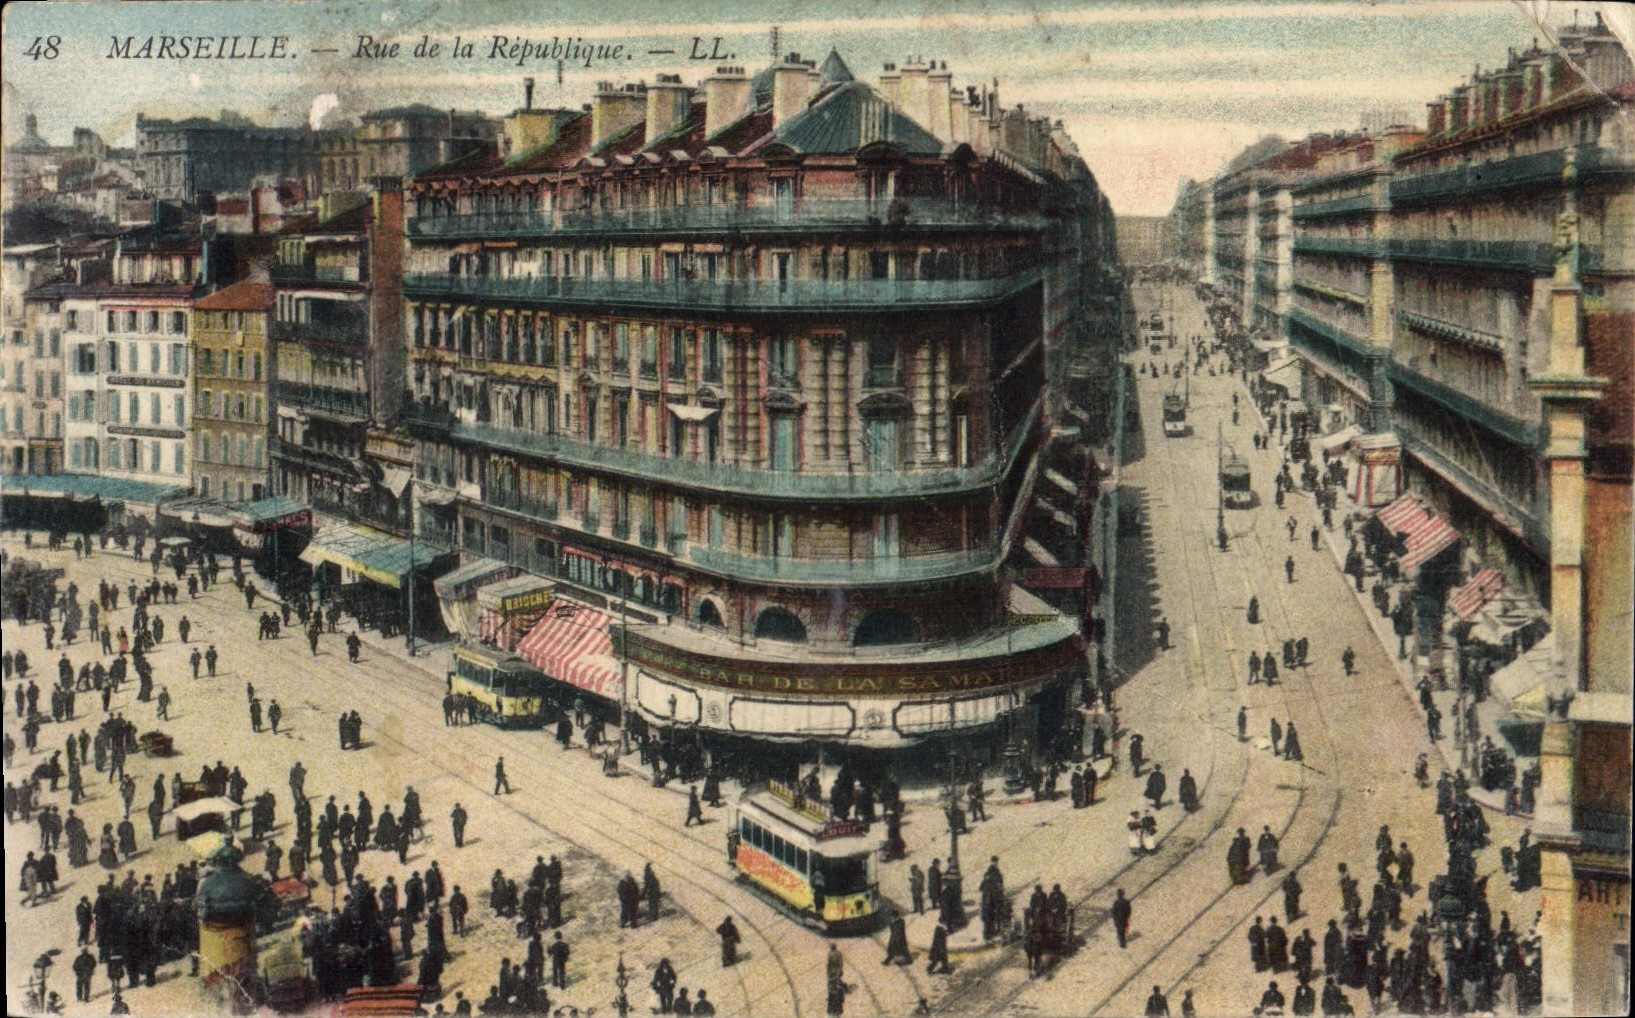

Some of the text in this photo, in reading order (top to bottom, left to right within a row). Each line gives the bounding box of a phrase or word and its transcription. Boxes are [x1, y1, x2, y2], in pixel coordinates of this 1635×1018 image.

[699, 668, 754, 687] BAR
[774, 677, 814, 690] DE
[837, 677, 882, 691] LA
